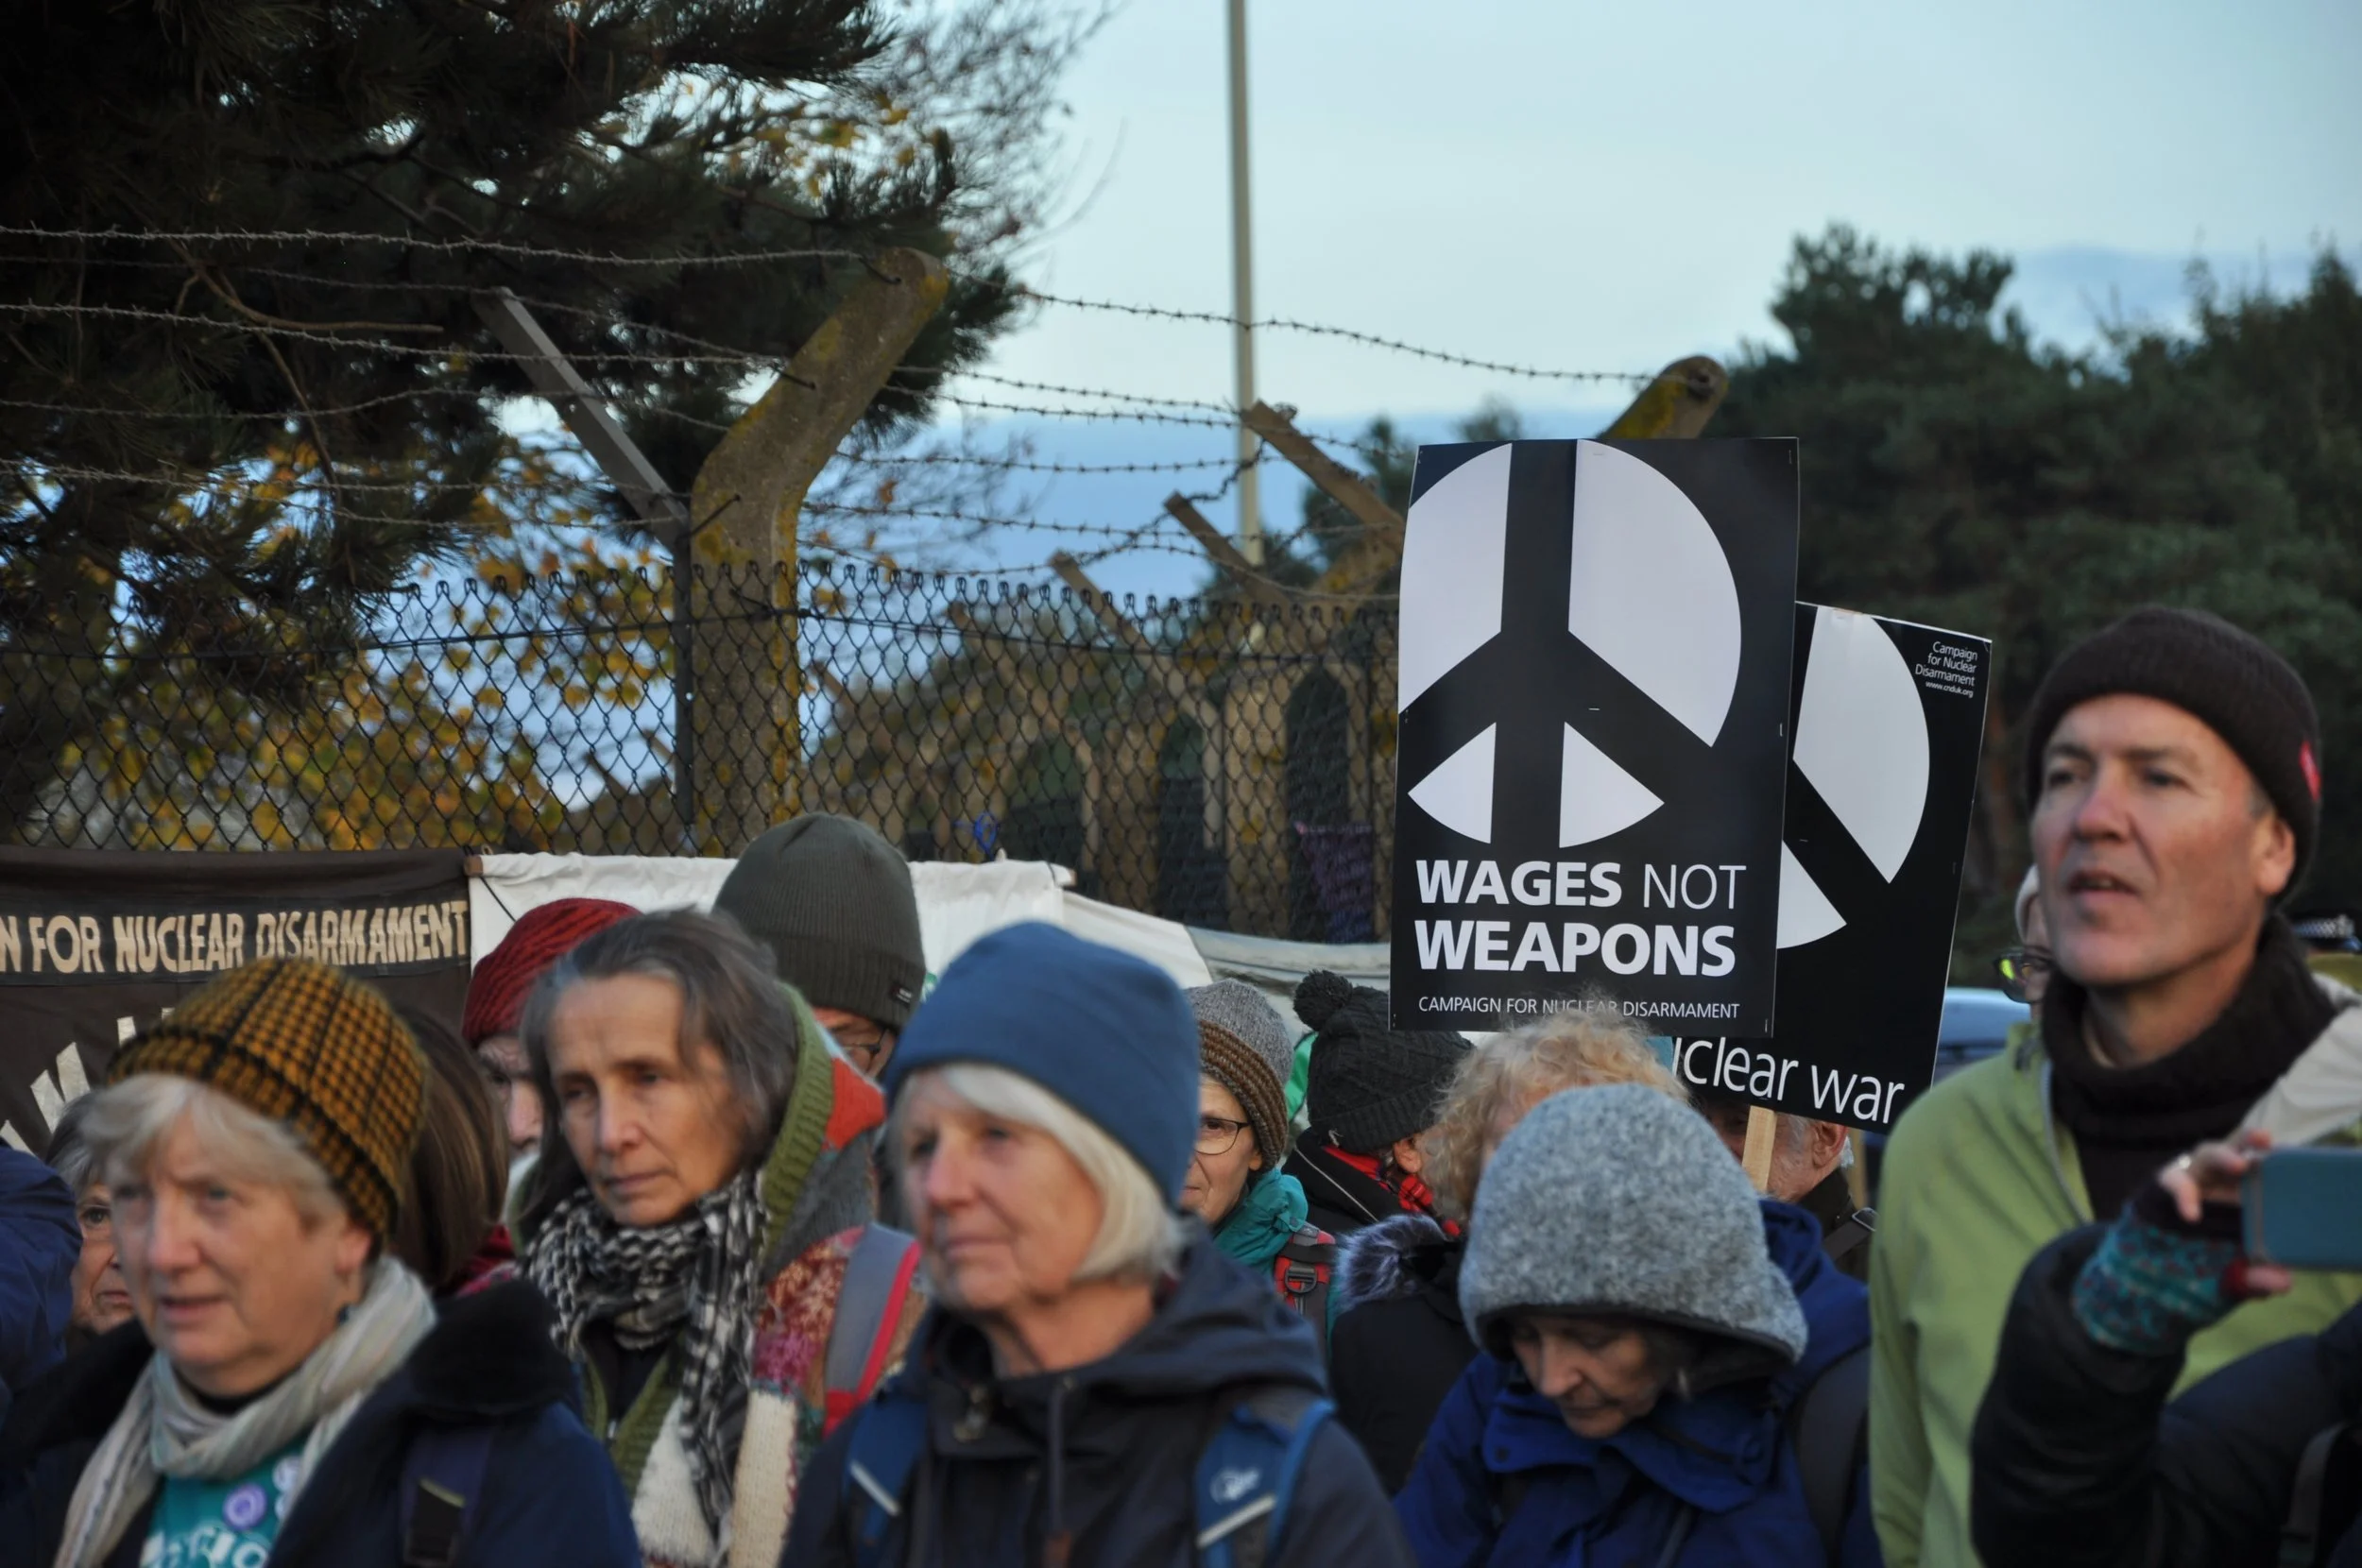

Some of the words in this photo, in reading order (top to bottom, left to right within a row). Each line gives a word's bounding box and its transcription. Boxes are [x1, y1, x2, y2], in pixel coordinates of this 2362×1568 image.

[1927, 653, 1942, 665] for
[1943, 656, 1977, 673] Nuclear
[1932, 641, 1978, 662] Campaign
[1915, 663, 1976, 687] Disarmament
[1926, 681, 1974, 698] www.cnduk.org
[1415, 860, 1622, 908] WAGES
[1644, 863, 1747, 910] NOT
[28, 914, 105, 974] FOR
[112, 912, 245, 973] NUCLEAR
[256, 900, 468, 966] DISARMAMENT
[1414, 919, 1736, 977] WEAPONS
[1418, 996, 1501, 1014] CAMPAIGN
[1506, 997, 1537, 1014] FOR
[1622, 1001, 1740, 1019] DISARMAMENT
[1671, 1036, 1799, 1101] clear
[1810, 1065, 1906, 1124] war
